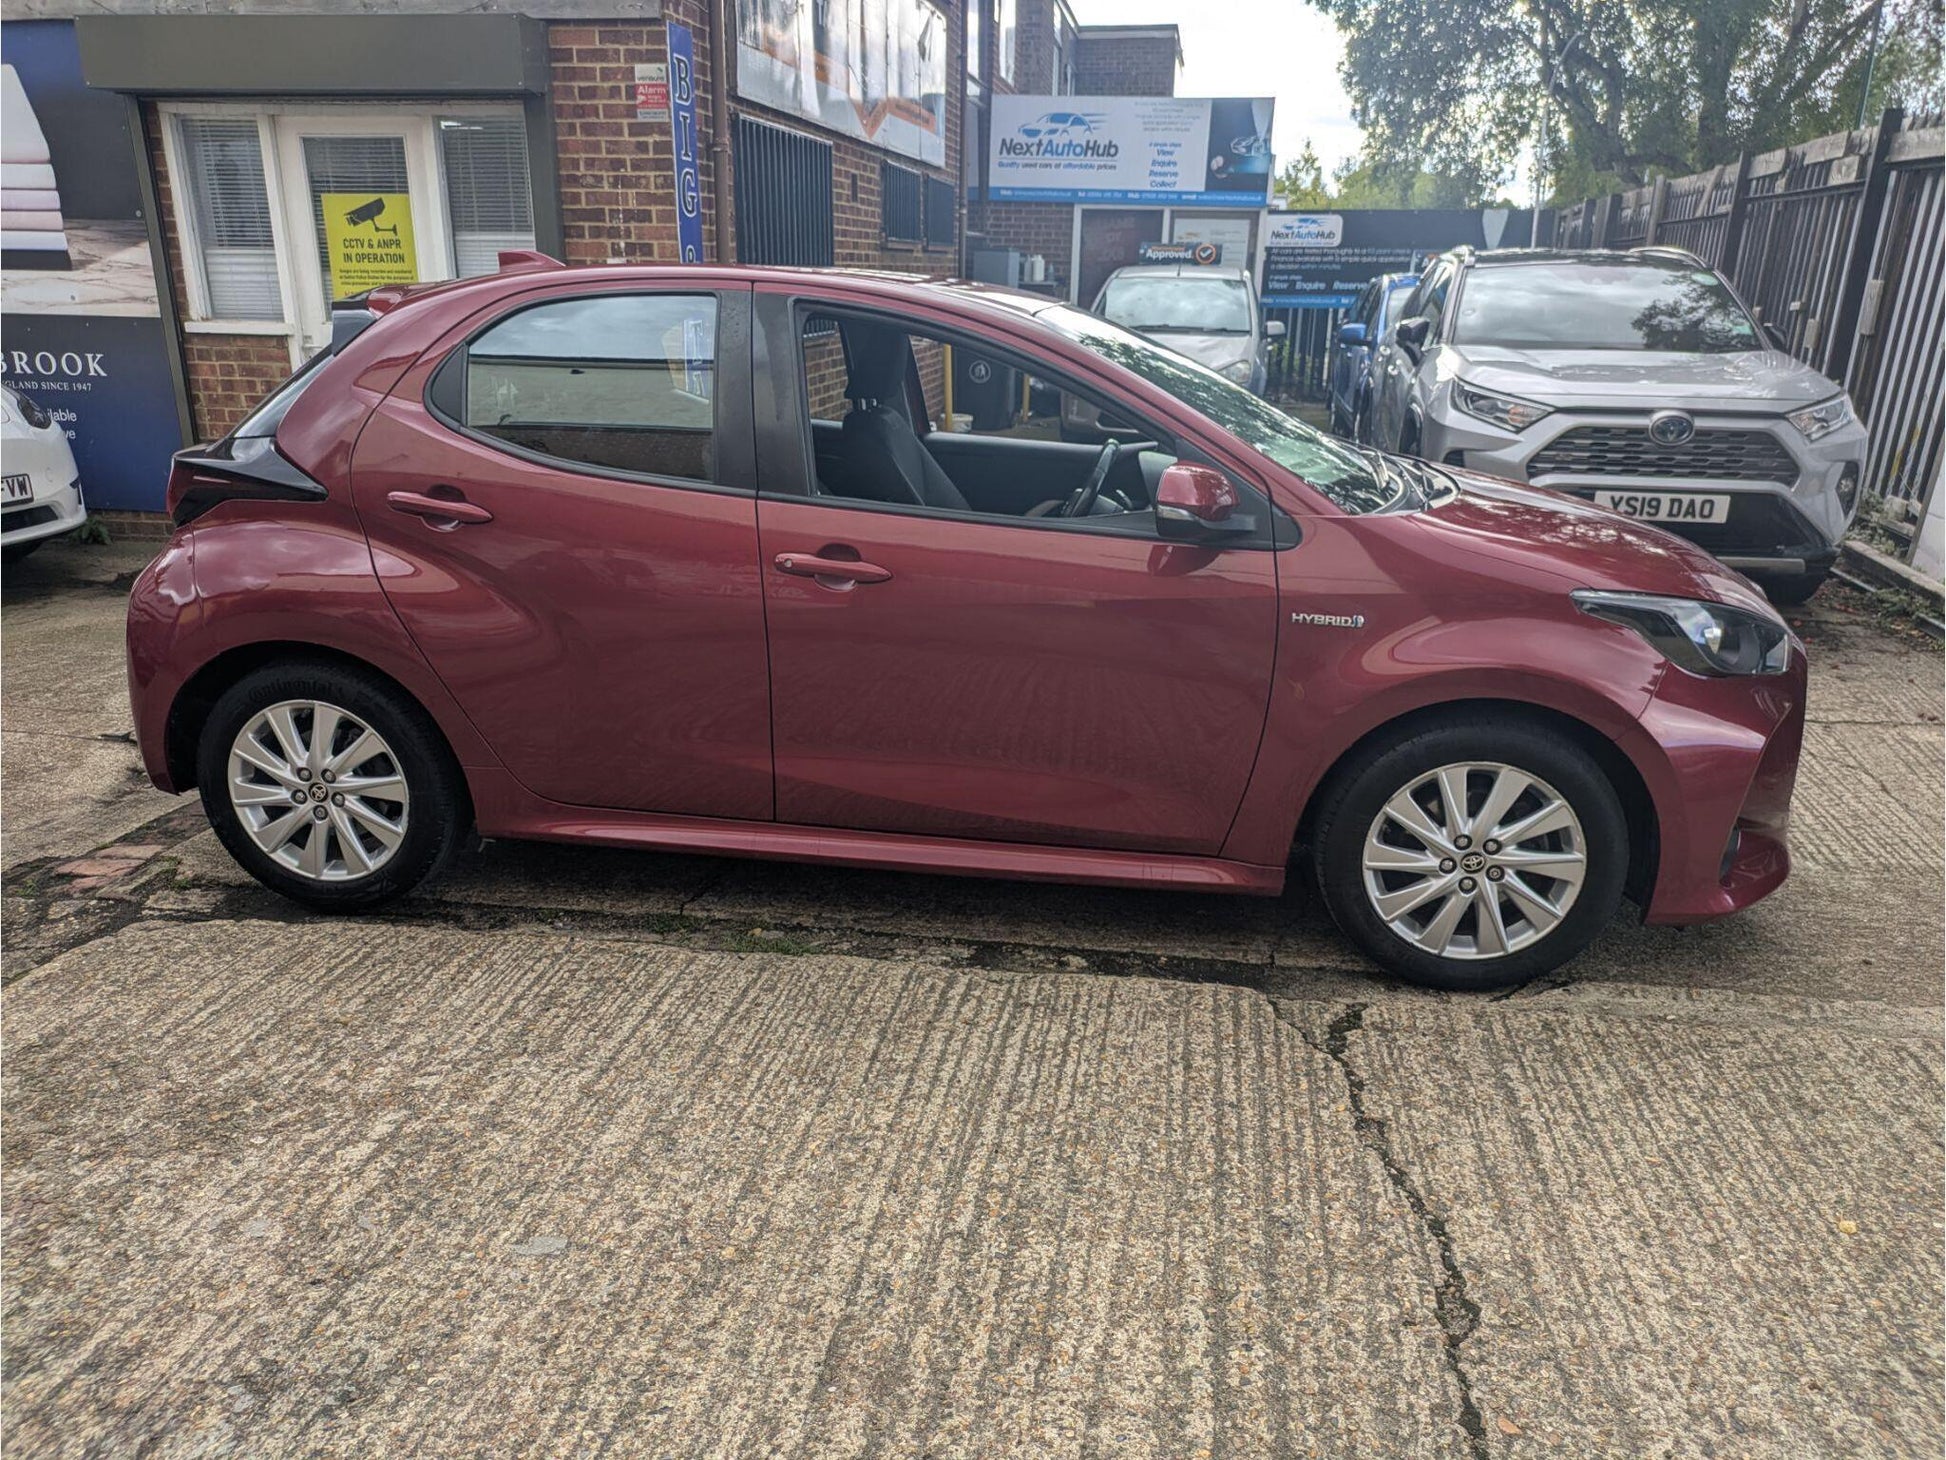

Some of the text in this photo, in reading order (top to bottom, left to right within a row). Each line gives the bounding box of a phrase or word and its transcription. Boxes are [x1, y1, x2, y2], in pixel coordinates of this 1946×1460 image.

[637, 85, 667, 95] Alarm
[673, 53, 698, 217] BIG
[999, 138, 1119, 158] NextAutoHub
[1096, 163, 1117, 172] prices
[1151, 159, 1177, 168] Enquire
[1149, 169, 1178, 178] Reserve
[1150, 180, 1177, 188] Collect
[1271, 230, 1336, 240] NextAutoHub
[343, 238, 401, 249] CCTV & ANPR
[343, 253, 405, 263] IN OPERATION
[1268, 281, 1288, 290] View
[1296, 281, 1326, 291] Enquire
[41, 381, 68, 391] SINCE
[71, 382, 91, 391] 1947
[1611, 495, 1715, 519] YS19 DAO
[1292, 613, 1353, 627] HYBRID
